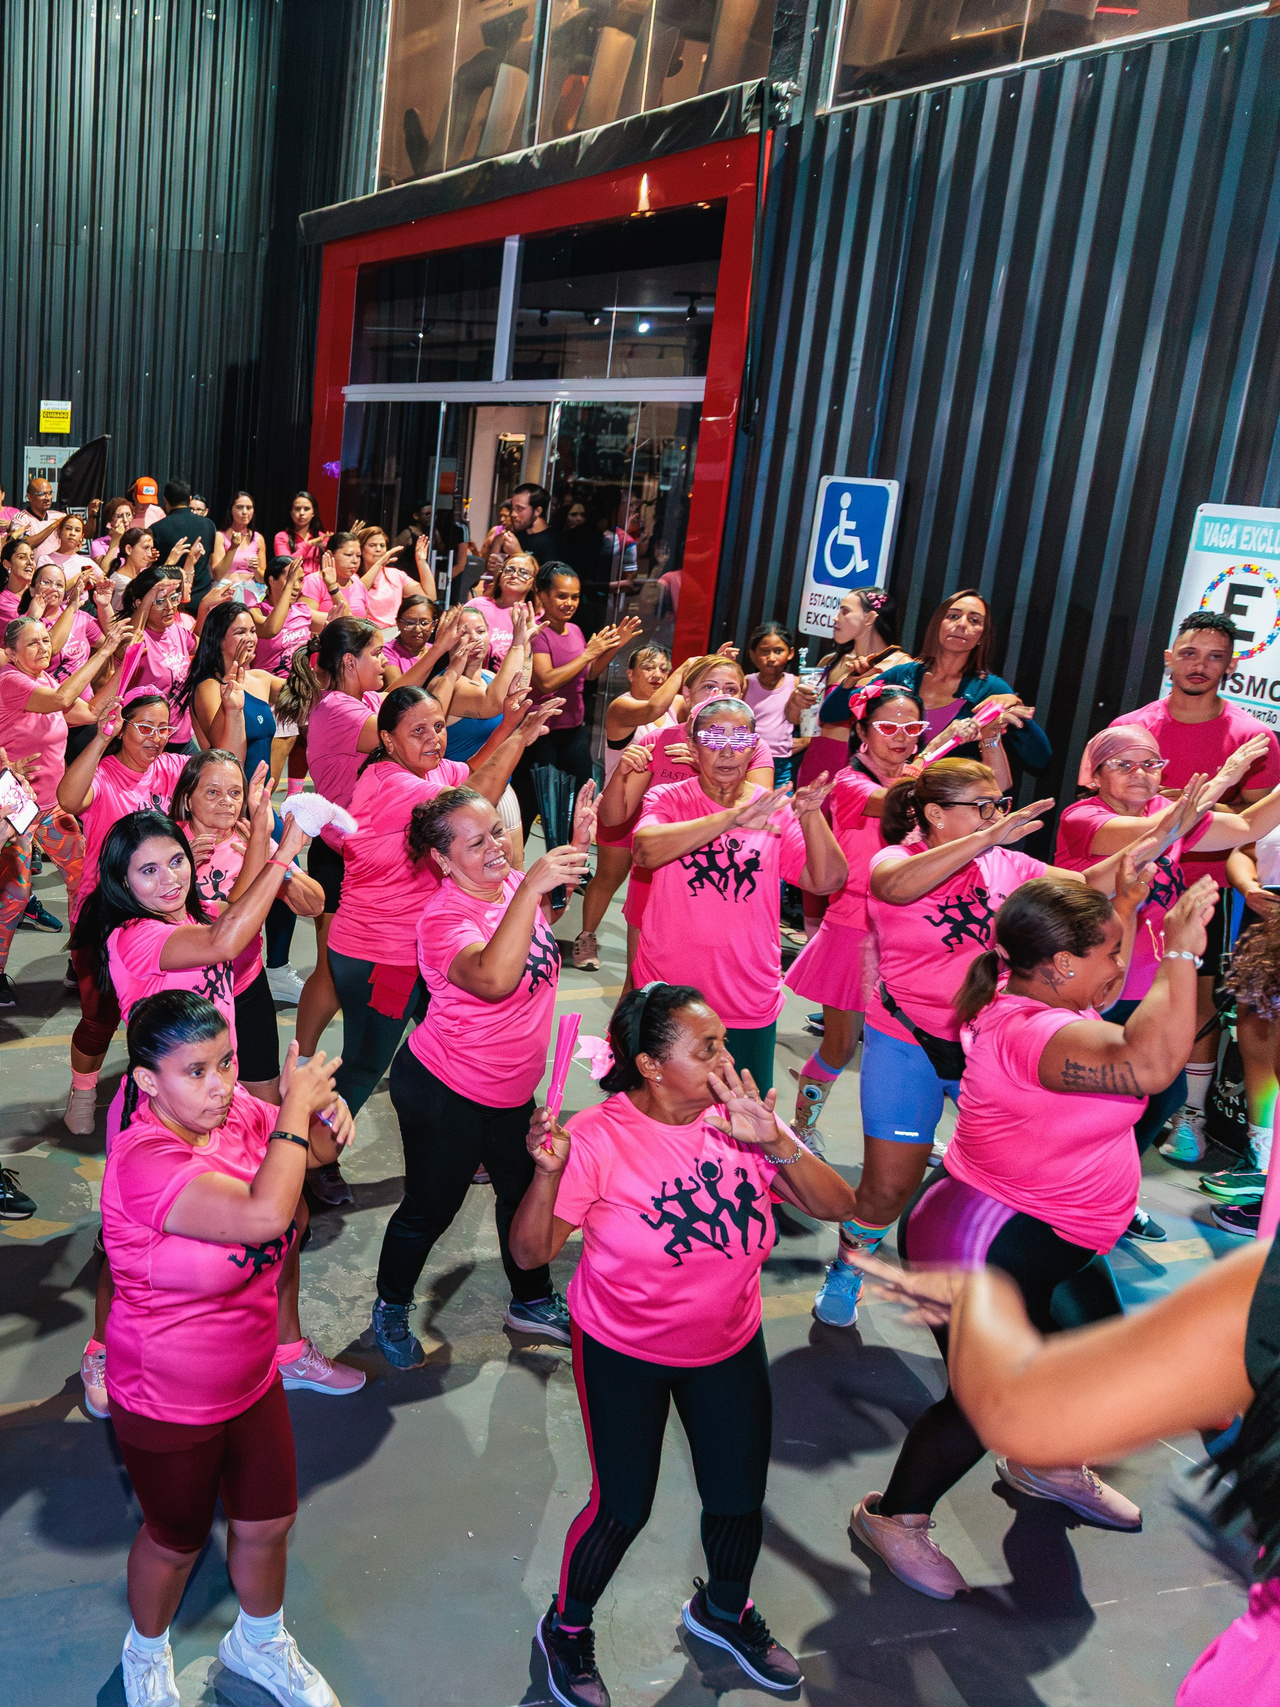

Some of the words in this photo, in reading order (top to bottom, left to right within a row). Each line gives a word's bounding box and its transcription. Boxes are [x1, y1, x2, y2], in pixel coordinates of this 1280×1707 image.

[1203, 522, 1239, 549] VAGA
[805, 611, 836, 628] EXCL
[1223, 582, 1265, 642] E
